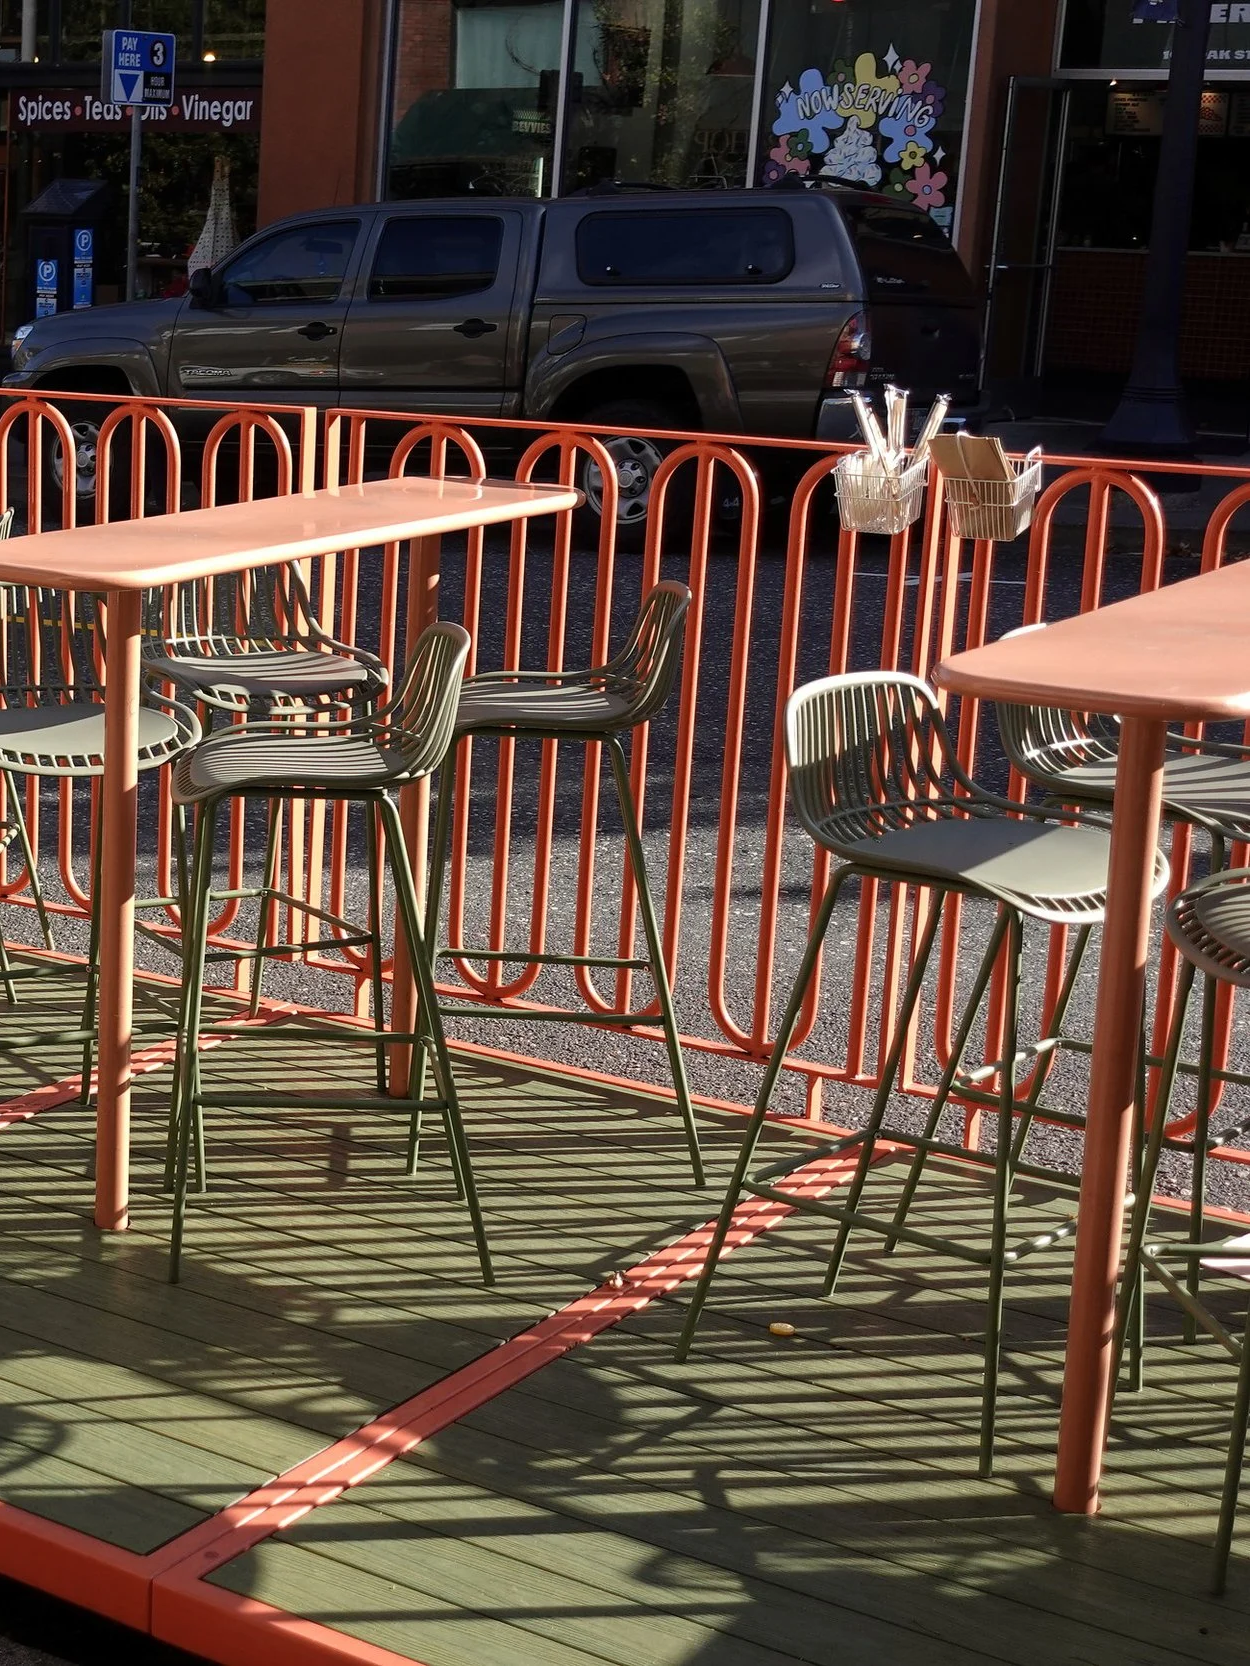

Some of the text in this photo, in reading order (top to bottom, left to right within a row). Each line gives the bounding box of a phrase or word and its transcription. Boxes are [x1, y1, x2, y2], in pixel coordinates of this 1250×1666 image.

[121, 36, 138, 51] PAY
[118, 52, 141, 67] HERE
[153, 42, 164, 66] 3
[1206, 49, 1231, 60] AK
[18, 94, 72, 126] Spices
[84, 95, 123, 121] Teas
[182, 94, 254, 127] Vinegar
[797, 84, 839, 120] NOW
